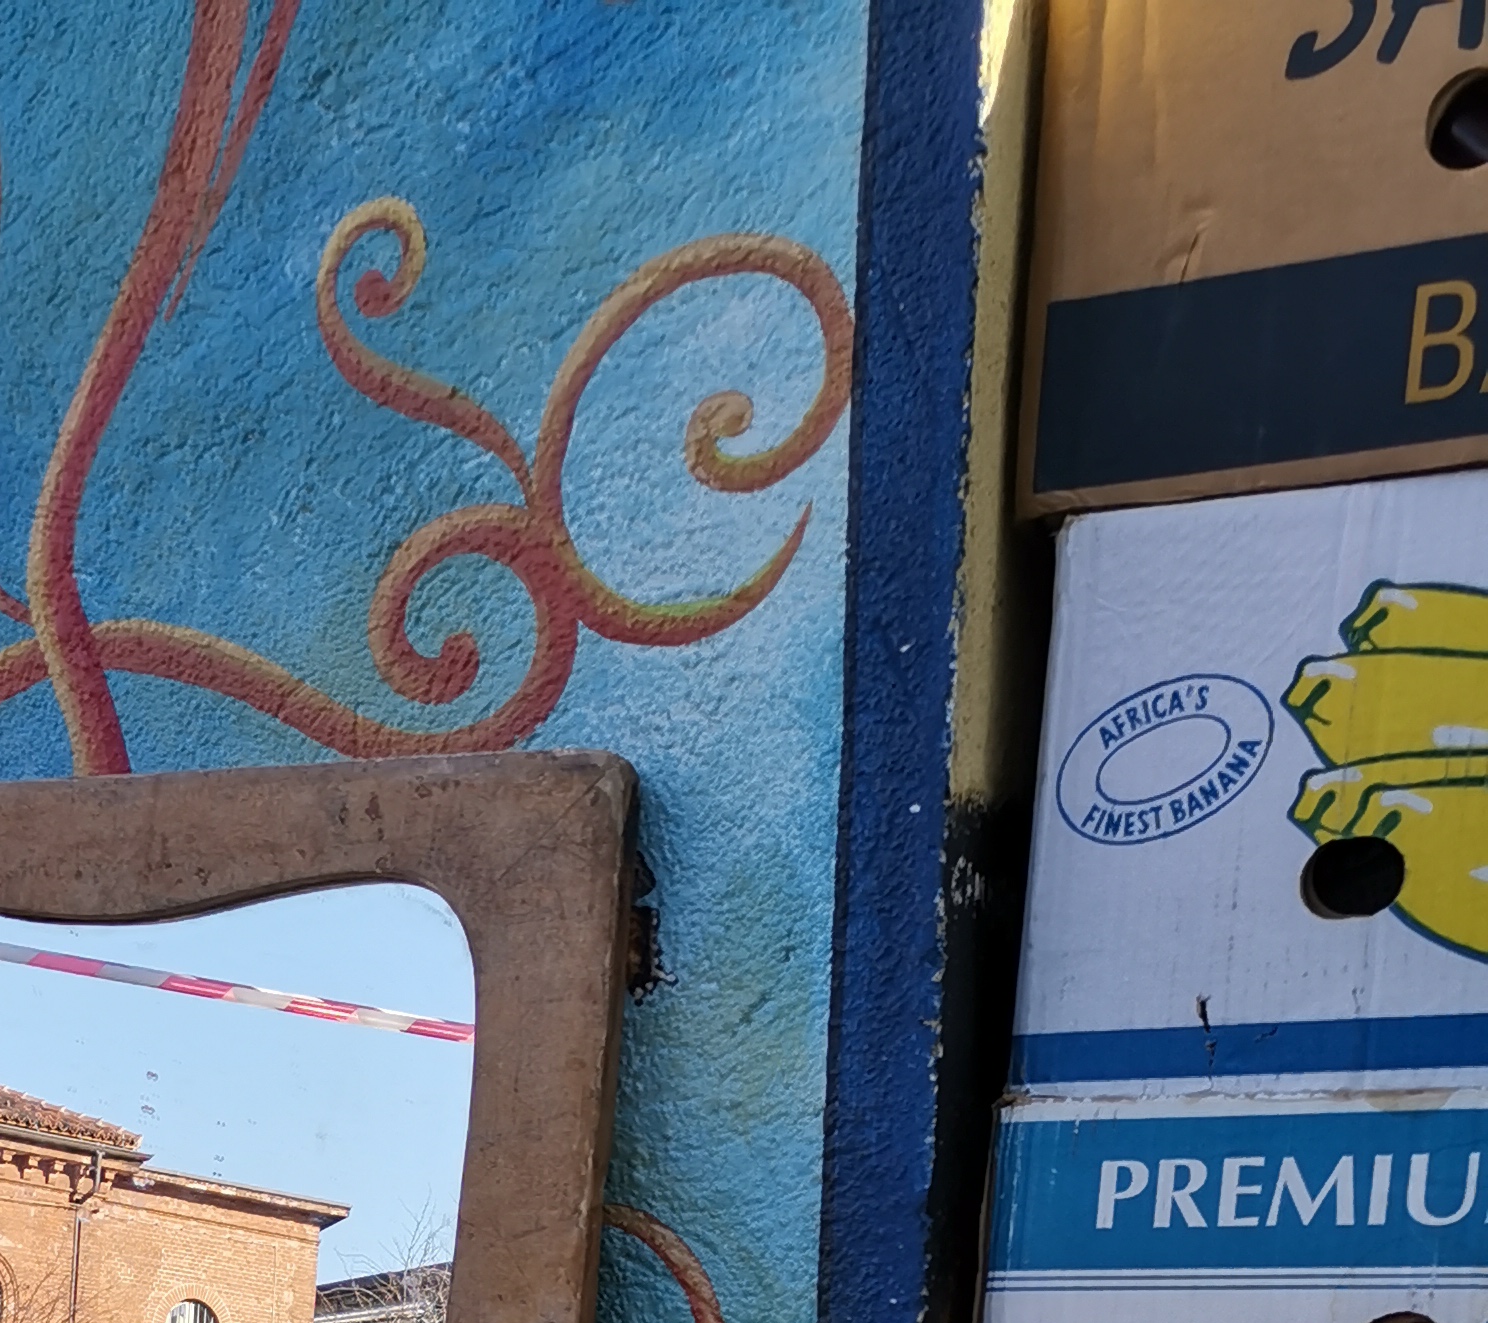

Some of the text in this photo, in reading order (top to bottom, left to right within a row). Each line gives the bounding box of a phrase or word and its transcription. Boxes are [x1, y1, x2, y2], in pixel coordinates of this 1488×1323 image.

[1405, 280, 1488, 404] B
[1099, 684, 1210, 750] AFRICA'S
[1080, 739, 1263, 838] FINEST BANANA
[1095, 1151, 1488, 1230] PREMIU
